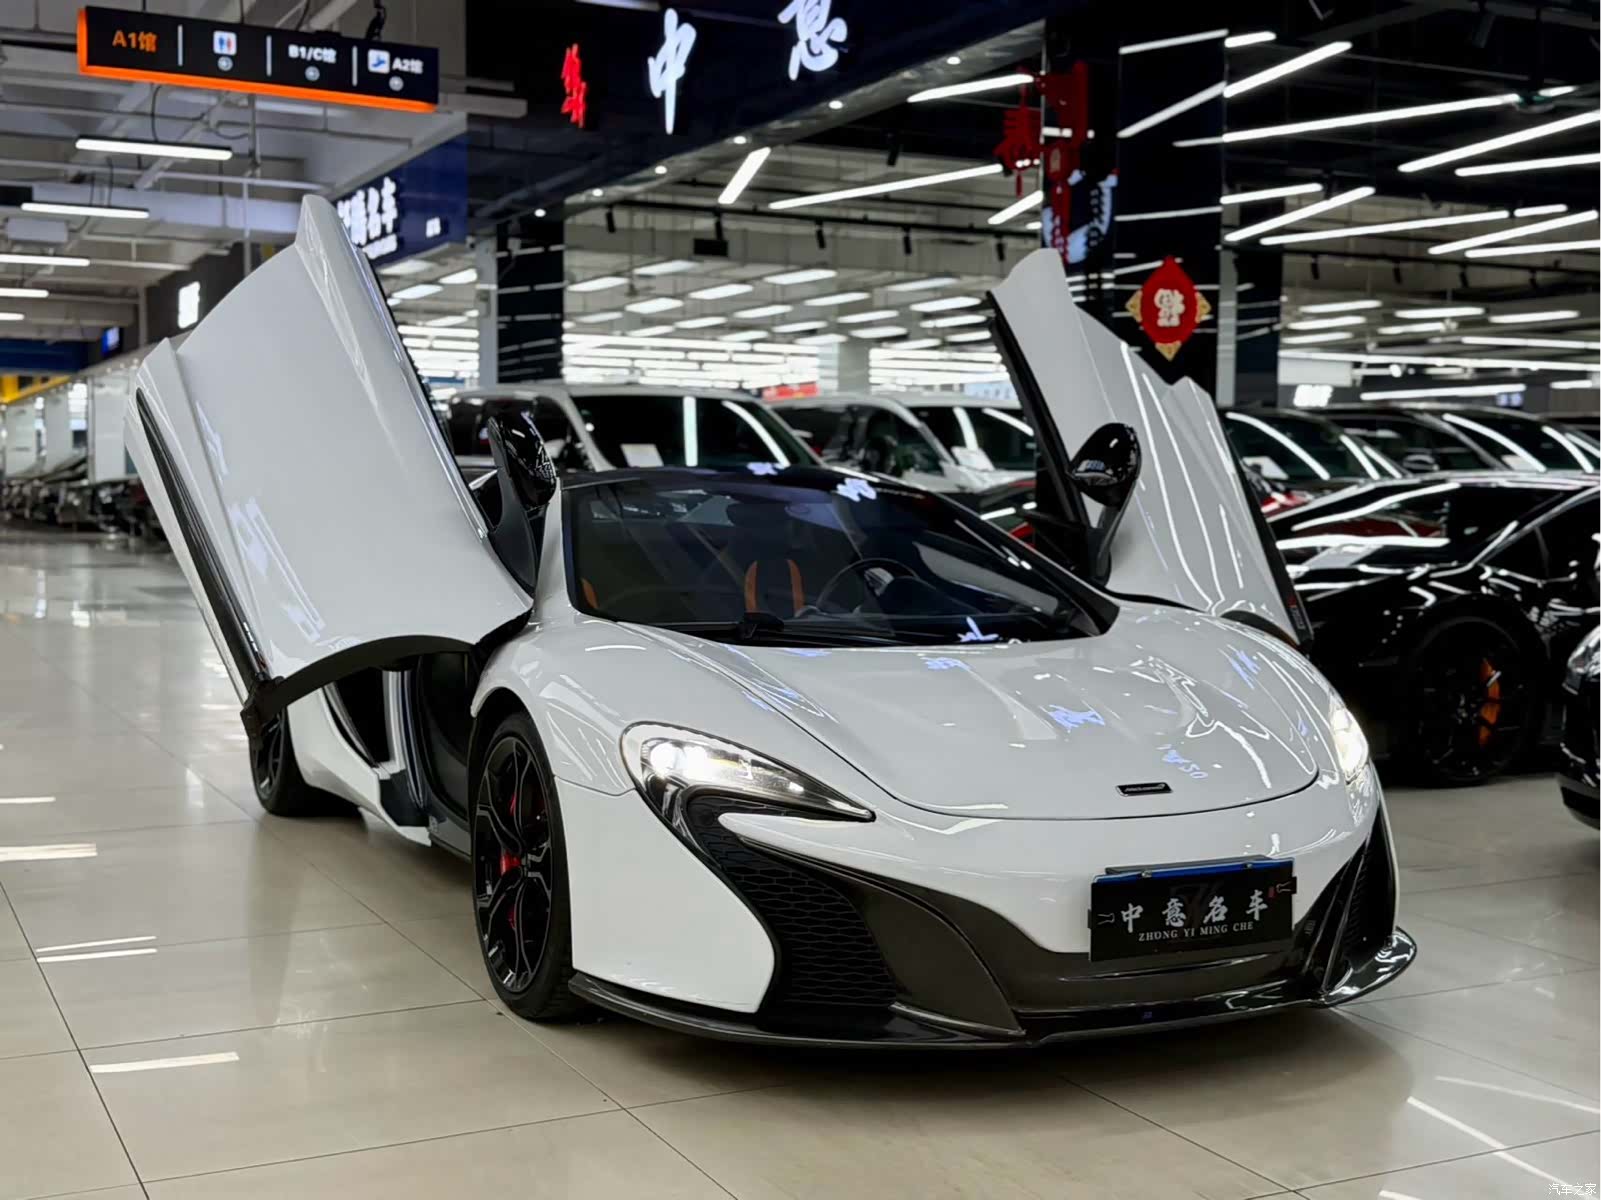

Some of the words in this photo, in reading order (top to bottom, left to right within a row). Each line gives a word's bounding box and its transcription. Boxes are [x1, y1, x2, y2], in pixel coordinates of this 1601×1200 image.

[112, 30, 157, 52] A1馆
[1120, 889, 1268, 933] 中意名车
[1138, 929, 1178, 942] ZHONG
[1184, 928, 1195, 938] YI
[1200, 924, 1228, 936] MING
[1233, 921, 1254, 932] CHE
